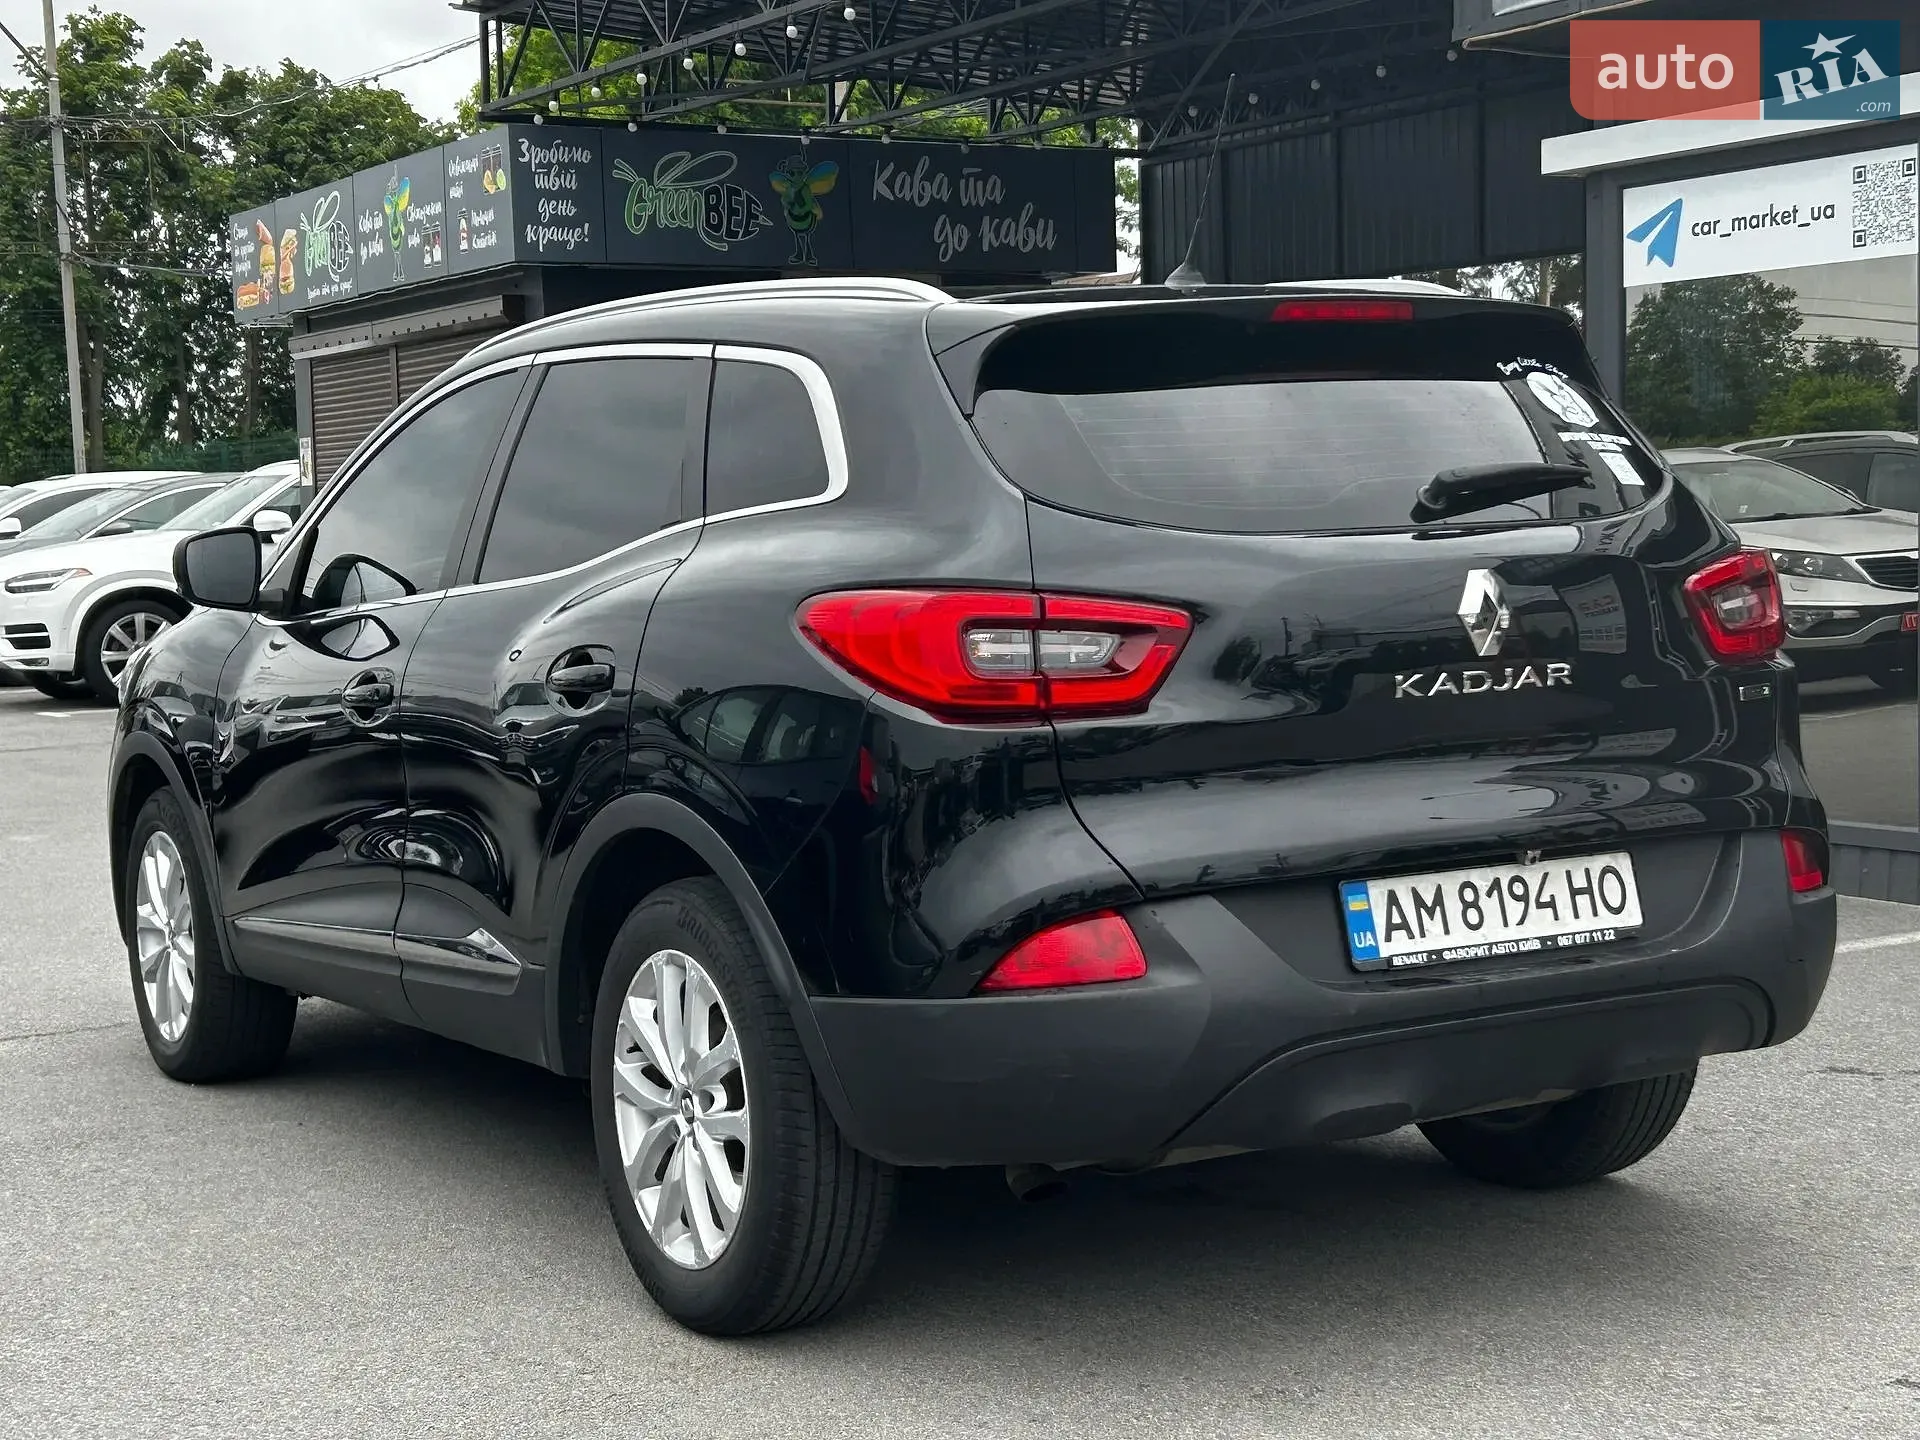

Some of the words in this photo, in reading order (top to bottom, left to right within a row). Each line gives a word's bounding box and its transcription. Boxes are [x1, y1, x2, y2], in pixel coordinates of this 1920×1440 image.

[518, 138, 592, 172] Зробимо
[533, 164, 578, 191] твій
[872, 155, 952, 208] Кава
[959, 167, 1006, 208] та
[537, 197, 577, 223] день
[1691, 203, 1836, 238] car_market_ua
[525, 222, 590, 253] краще!
[933, 213, 971, 263] до
[978, 202, 1058, 253] кави
[1394, 662, 1574, 699] KADJAR
[1384, 883, 1450, 943] AM
[1457, 871, 1560, 931] 8194
[1565, 865, 1627, 919] HO
[1353, 930, 1376, 949] UA
